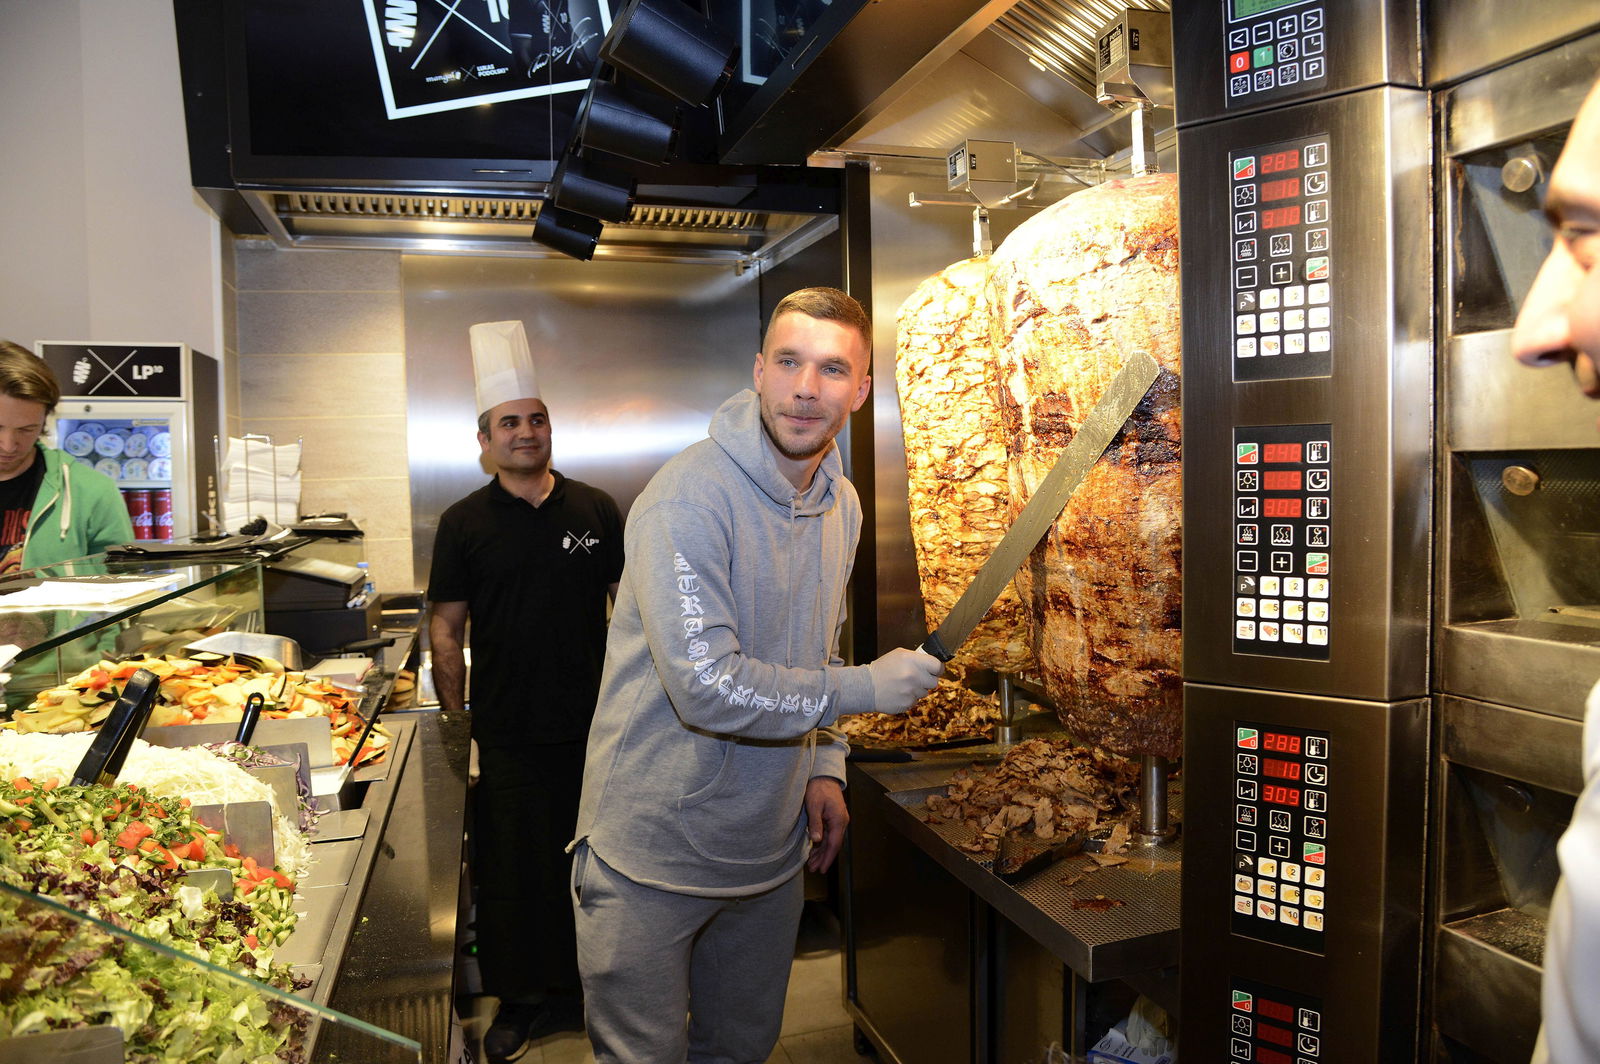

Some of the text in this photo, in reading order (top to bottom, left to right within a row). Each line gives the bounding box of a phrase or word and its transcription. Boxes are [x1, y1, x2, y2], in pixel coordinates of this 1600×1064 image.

[1260, 51, 1266, 61] 1
[1236, 57, 1244, 69] 0
[1309, 63, 1319, 75] P
[1240, 302, 1247, 310] P
[1240, 583, 1247, 591] P
[1292, 628, 1302, 636] 10
[1318, 628, 1327, 636] 11
[1264, 733, 1300, 753] 288
[1282, 762, 1300, 779] 10
[1264, 785, 1300, 806] 309
[1239, 861, 1245, 869] P
[1288, 911, 1298, 919] 10
[1314, 915, 1322, 923] 11
